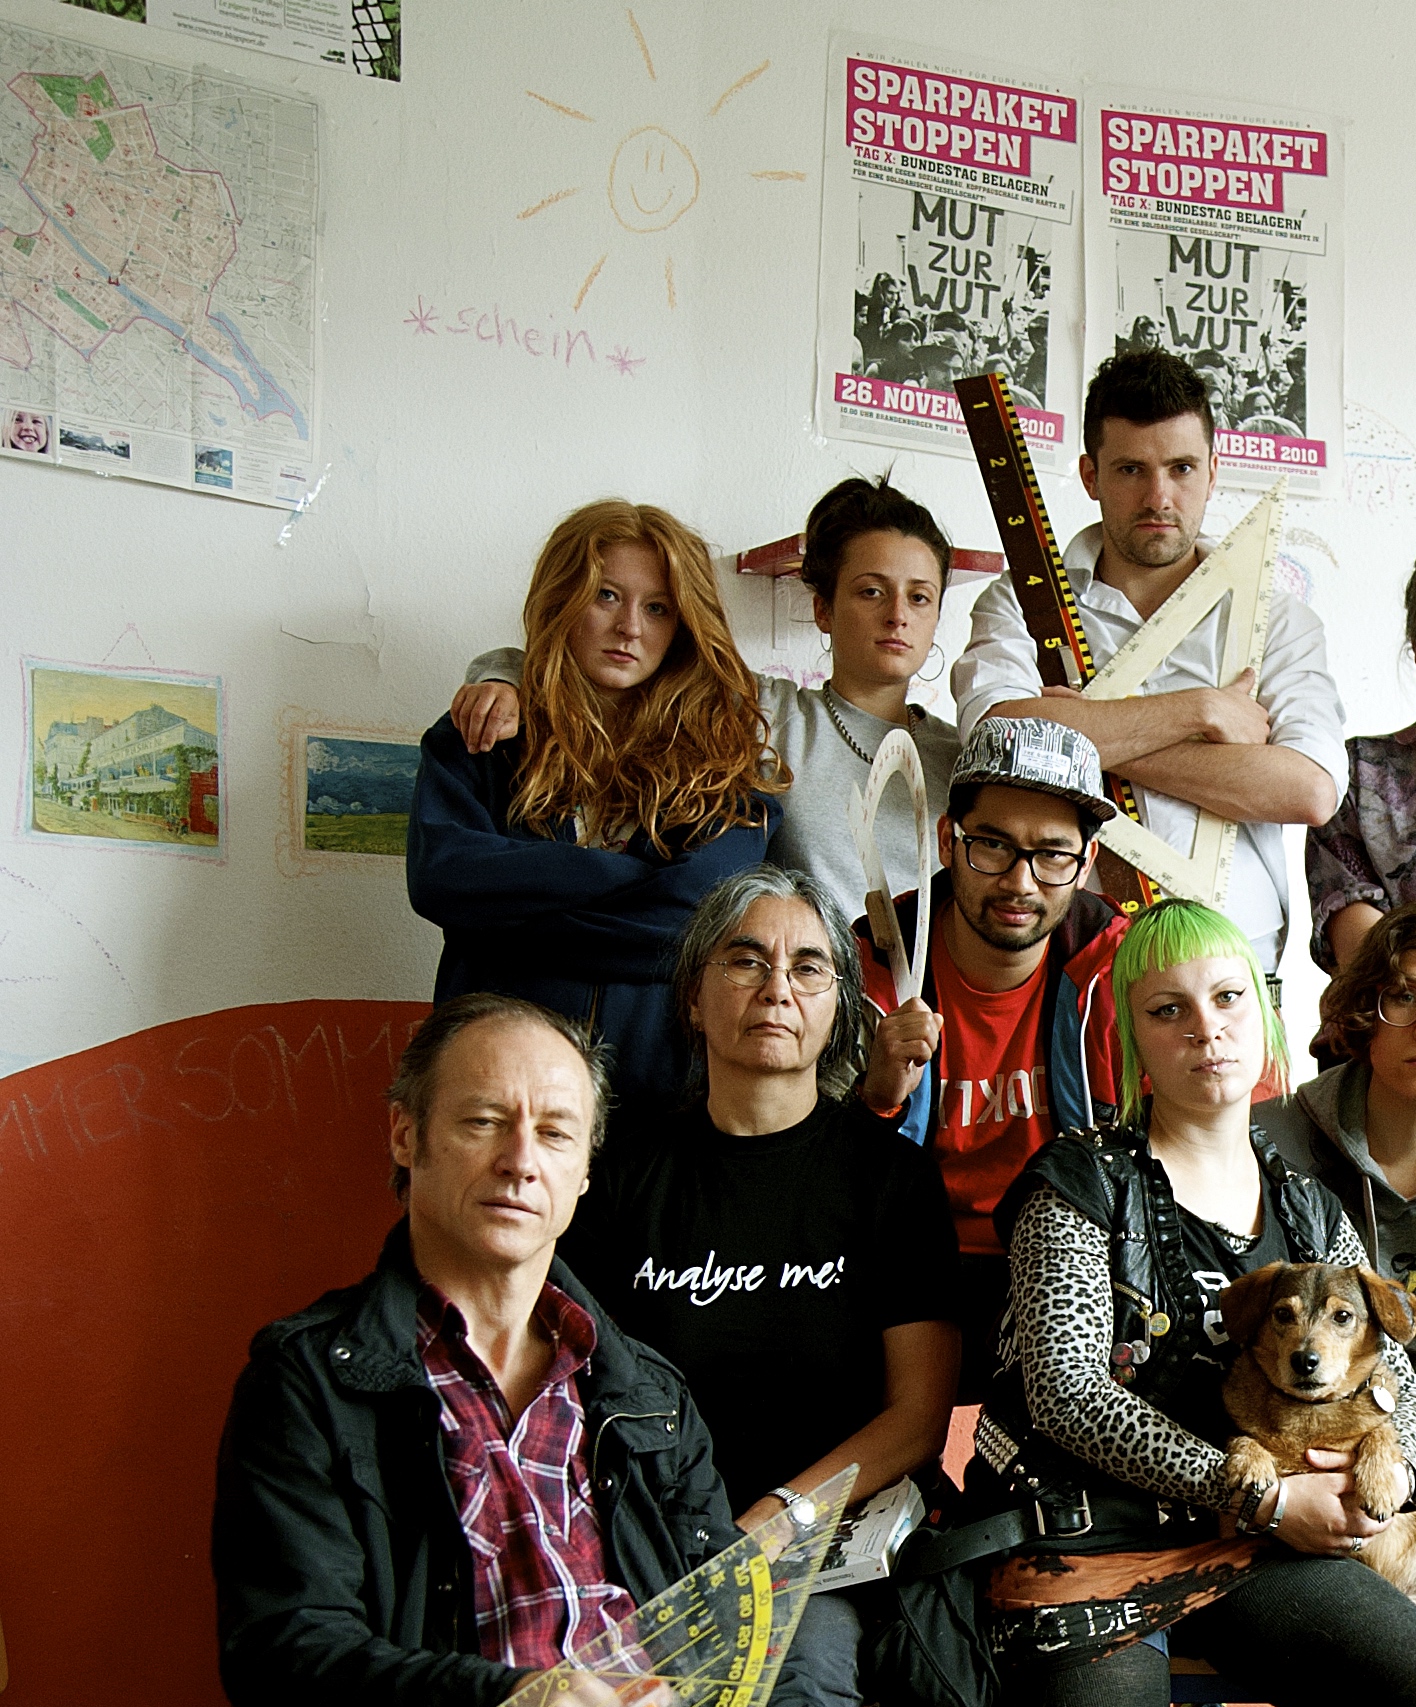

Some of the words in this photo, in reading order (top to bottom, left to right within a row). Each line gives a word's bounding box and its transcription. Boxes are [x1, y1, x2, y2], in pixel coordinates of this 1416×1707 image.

[853, 66, 1068, 135] SPARPAKET
[852, 108, 1022, 168] STOPPEN
[1107, 117, 1318, 170] SPARPAKET
[853, 159, 893, 173] GEMEINSAM
[895, 167, 916, 178] GEGEN
[1021, 194, 1034, 204] UND
[855, 145, 879, 161] TAG
[884, 151, 897, 165] X:
[901, 154, 977, 182] BUNDESTAG
[982, 172, 1049, 197] BELAGERN
[868, 171, 884, 181] EINE
[1108, 157, 1274, 205] STOPPEN
[912, 192, 1004, 247] MUT
[1111, 194, 1135, 208] TAG
[1139, 198, 1152, 210] X:
[1156, 200, 1231, 221] BUNDESTAG
[1236, 212, 1302, 231] BELAGERN
[1275, 230, 1288, 239] UND
[928, 241, 992, 282] ZUR
[1169, 235, 1260, 283] MUT
[908, 264, 1001, 319] WUT
[1185, 282, 1249, 318] ZUR
[1166, 306, 1258, 353] WUT
[841, 378, 877, 406] 26.
[883, 386, 966, 425] NOVEM
[1019, 417, 1055, 438] 2010
[1213, 432, 1276, 460] MBER
[1280, 446, 1318, 464] 2010
[990, 457, 1007, 469] 2
[1008, 515, 1025, 526] 3
[1026, 575, 1043, 586] 4
[1045, 637, 1062, 649] 5
[177, 1020, 424, 1124] SOMM
[633, 1250, 767, 1306] Analyse
[780, 1256, 845, 1290] me!
